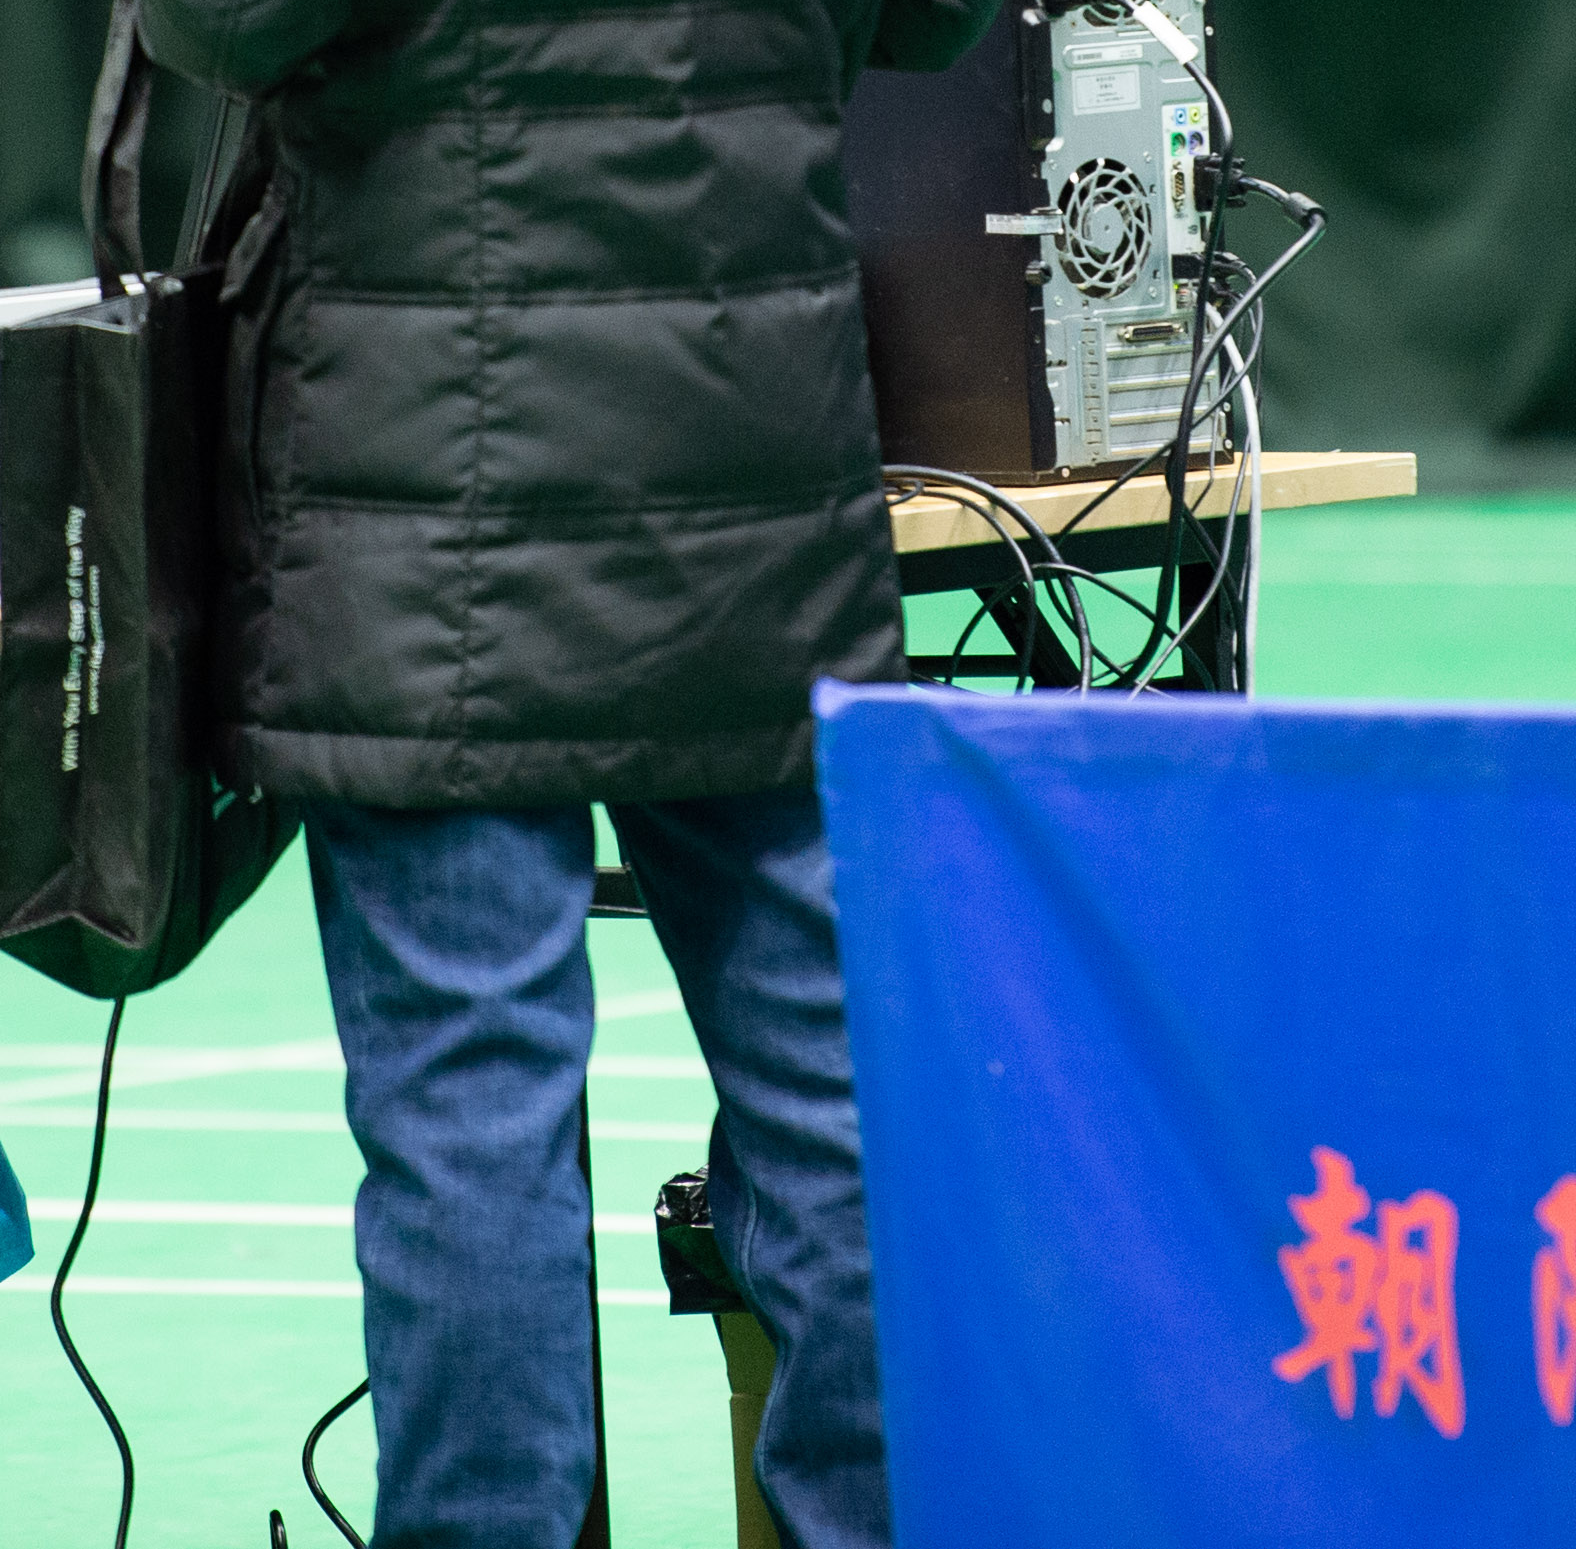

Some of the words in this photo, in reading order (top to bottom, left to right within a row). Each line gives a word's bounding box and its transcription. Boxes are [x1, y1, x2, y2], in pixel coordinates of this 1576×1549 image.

[65, 505, 86, 546] Way
[66, 545, 84, 577] the
[66, 577, 84, 599] of
[67, 599, 86, 642] Step
[63, 644, 87, 691] Every
[62, 692, 81, 728] You
[61, 730, 81, 772] With
